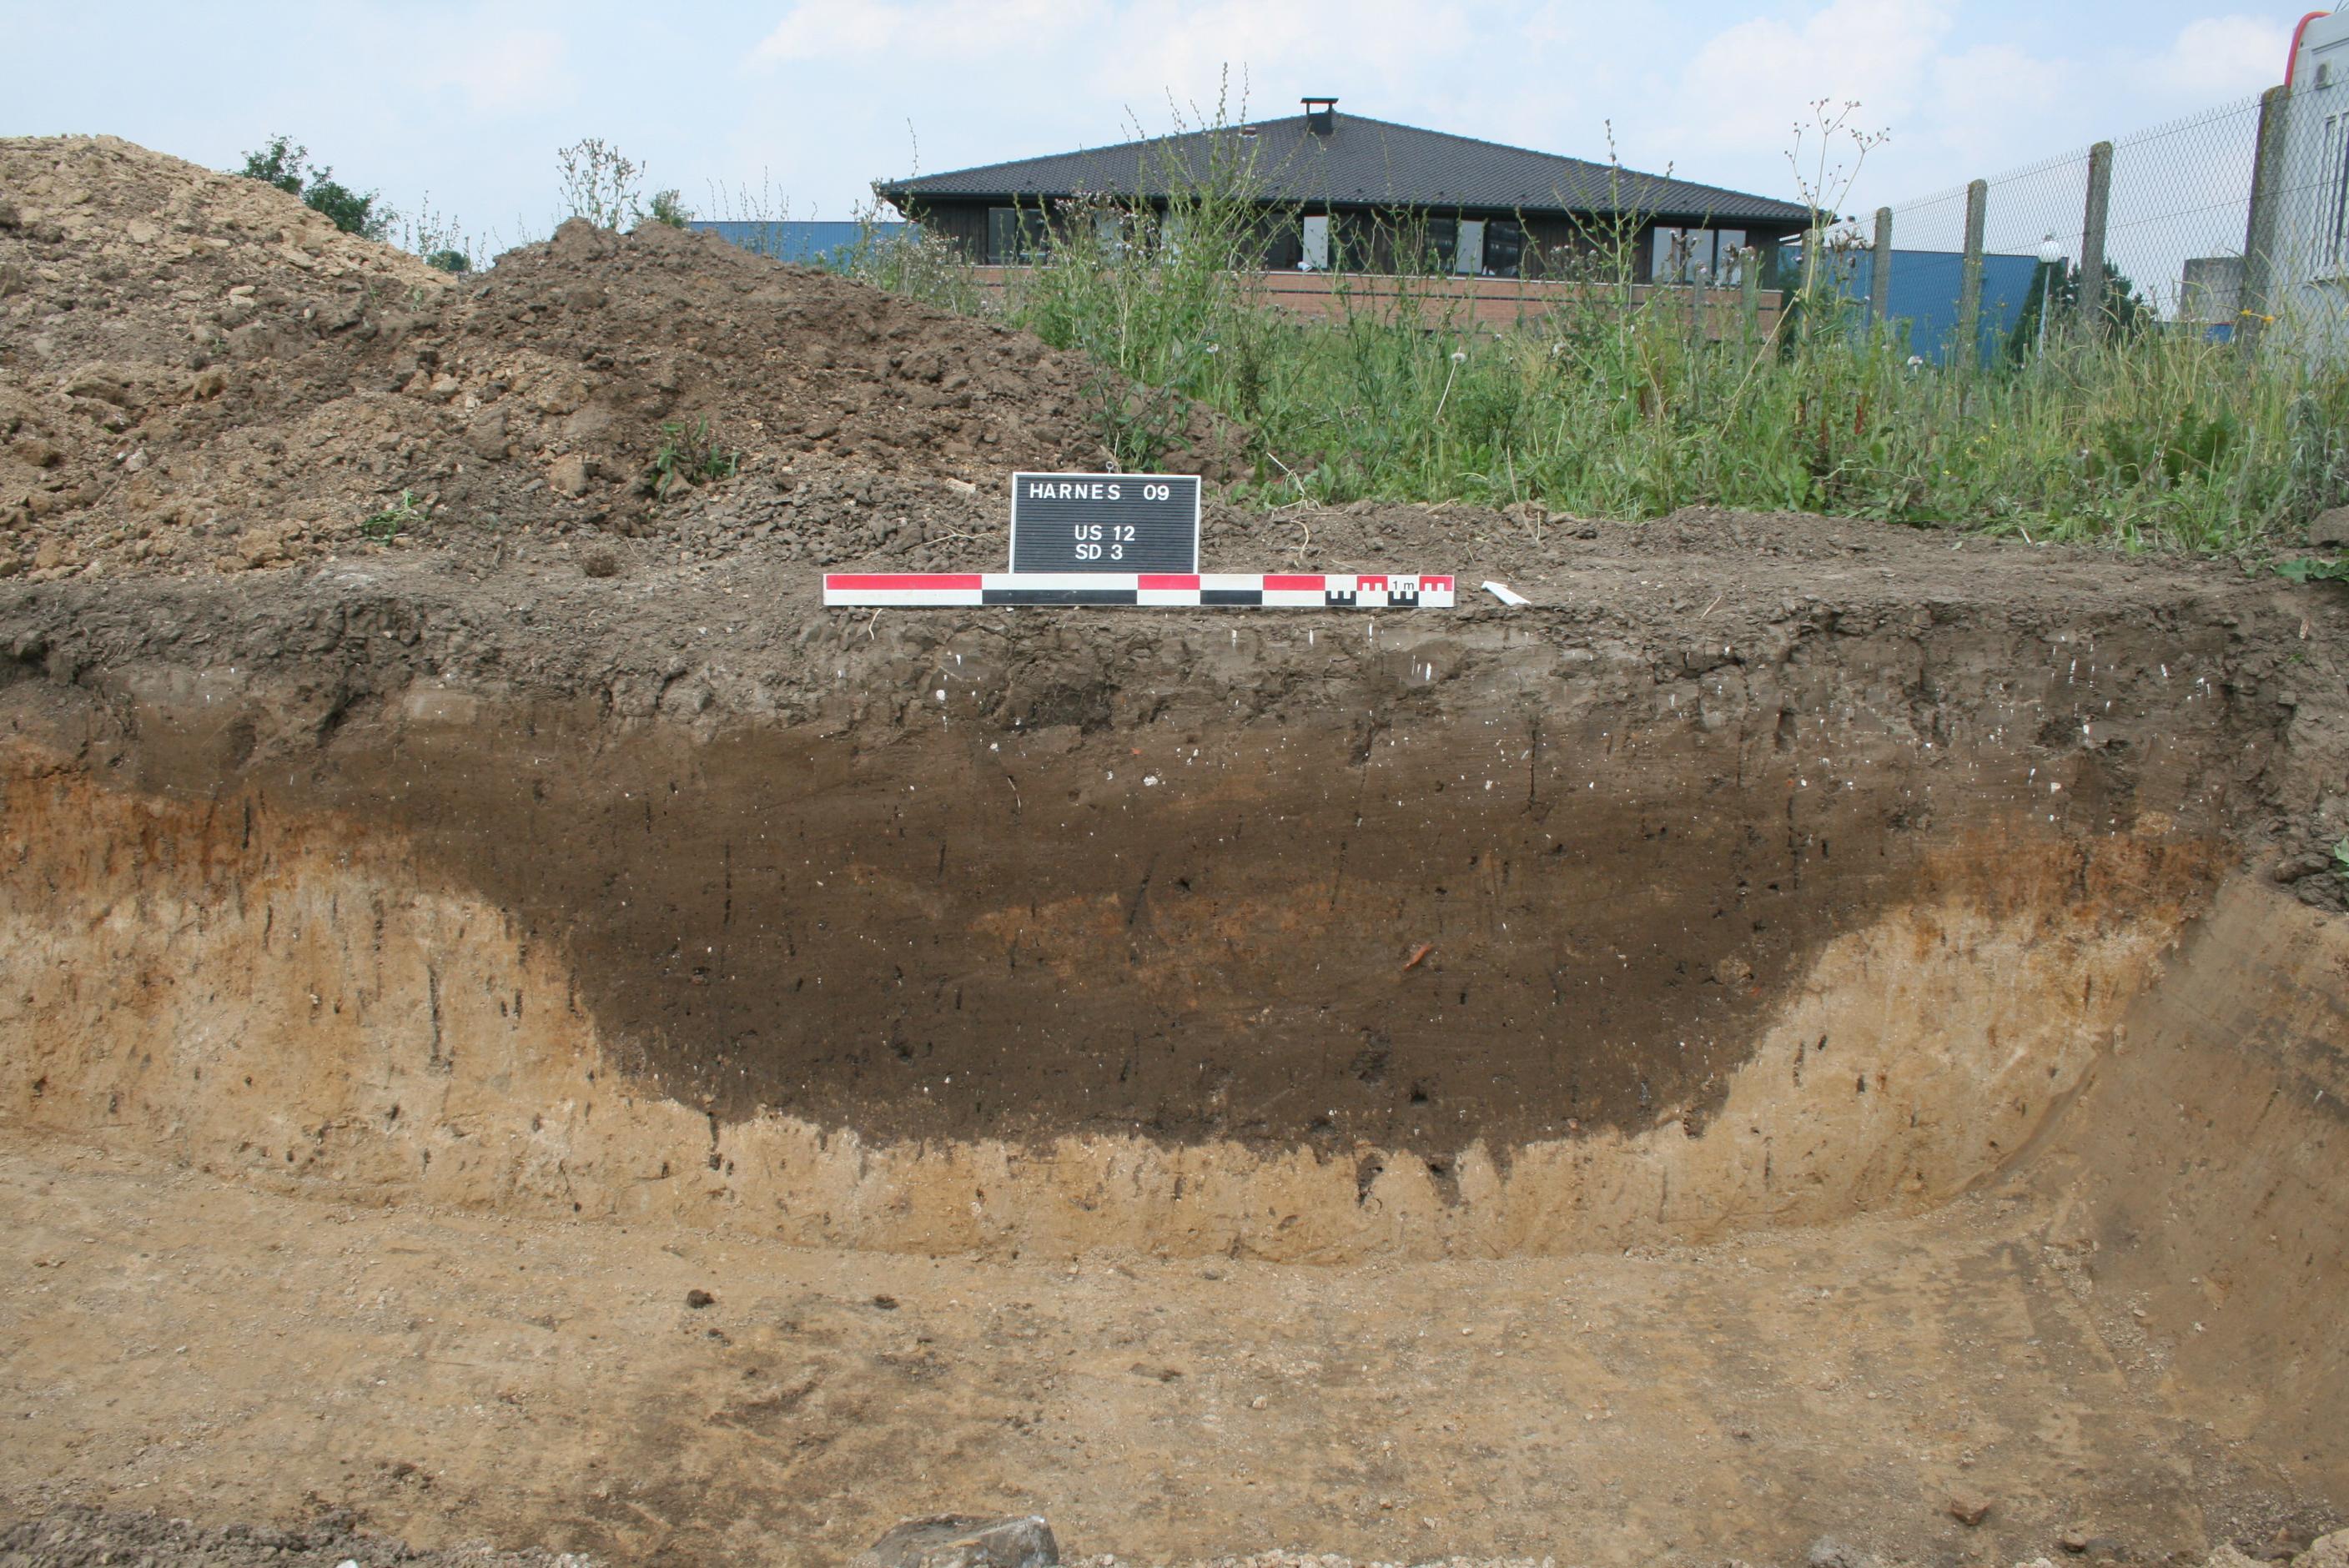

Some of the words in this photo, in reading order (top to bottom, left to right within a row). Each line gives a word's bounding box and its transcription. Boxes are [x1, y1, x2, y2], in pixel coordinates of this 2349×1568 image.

[1029, 483, 1121, 500] HARNES
[1143, 485, 1169, 500] 09
[1074, 525, 1103, 540] US
[1114, 525, 1135, 541] 12
[1074, 544, 1102, 560] SD
[1110, 544, 1123, 560] 3
[1392, 580, 1398, 590] 1
